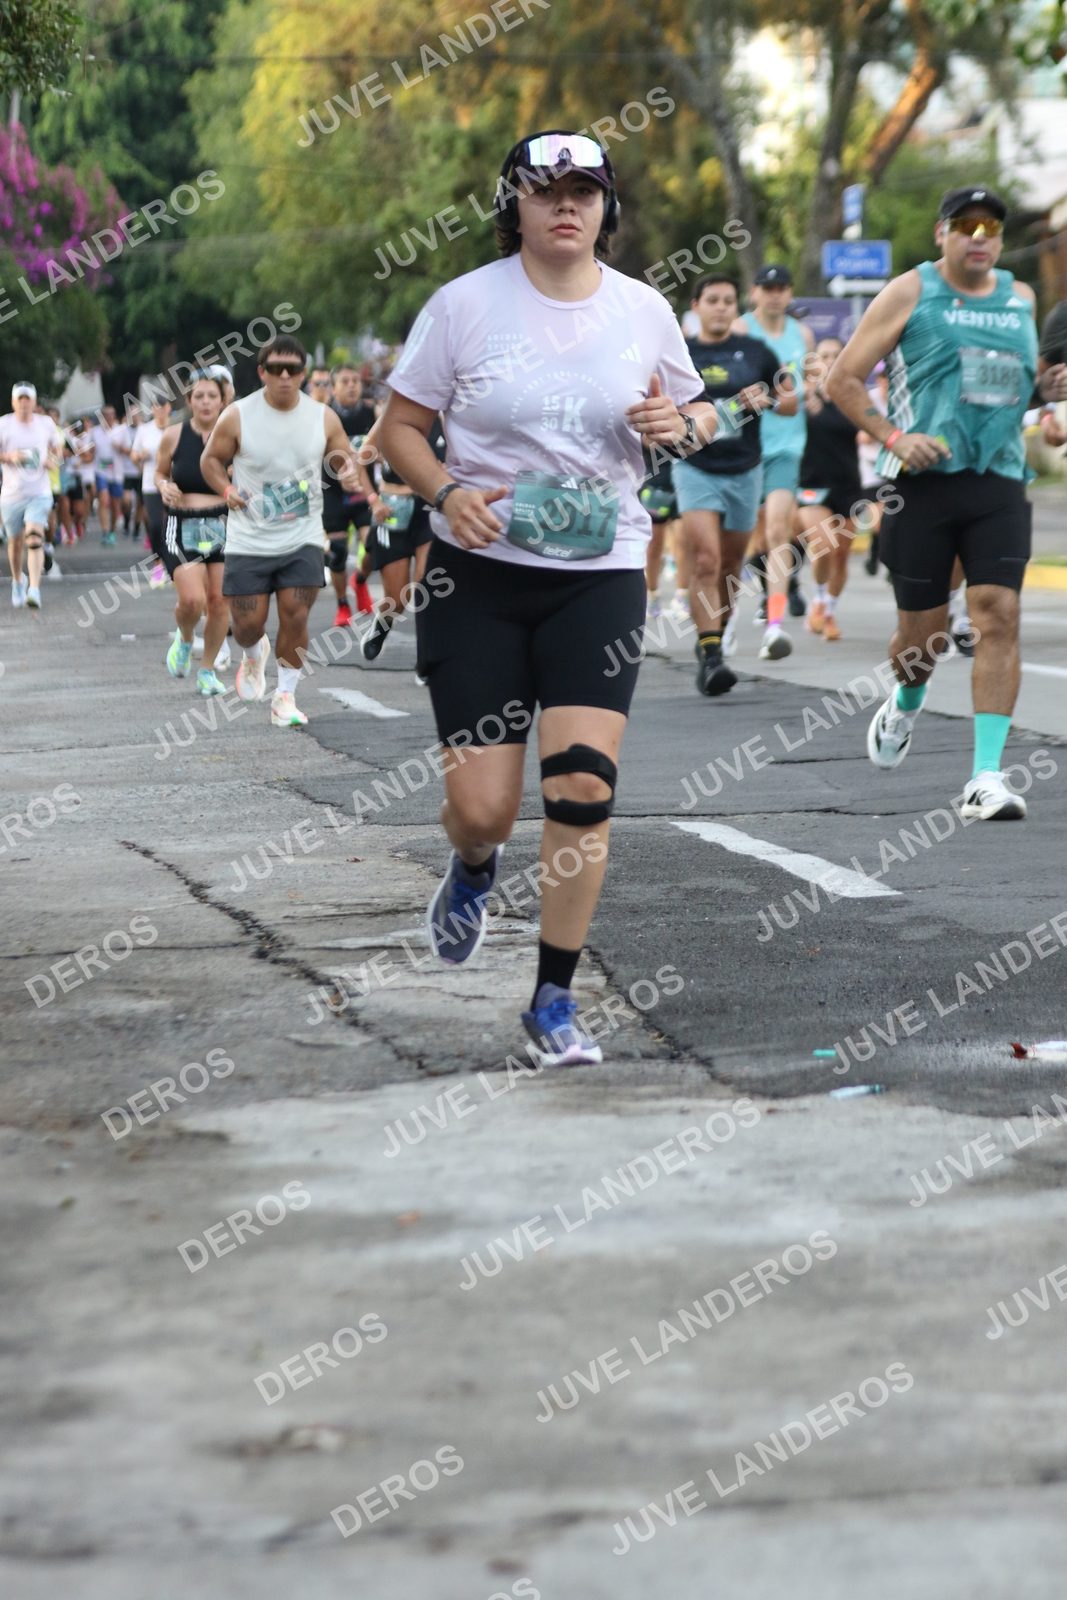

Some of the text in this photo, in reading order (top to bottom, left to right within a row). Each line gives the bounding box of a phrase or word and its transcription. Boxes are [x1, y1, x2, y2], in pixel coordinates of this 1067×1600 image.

[943, 309, 1021, 330] VENTUS
[541, 395, 560, 411] 15
[562, 396, 588, 433] K
[540, 417, 558, 433] 30
[542, 545, 573, 557] telcel
